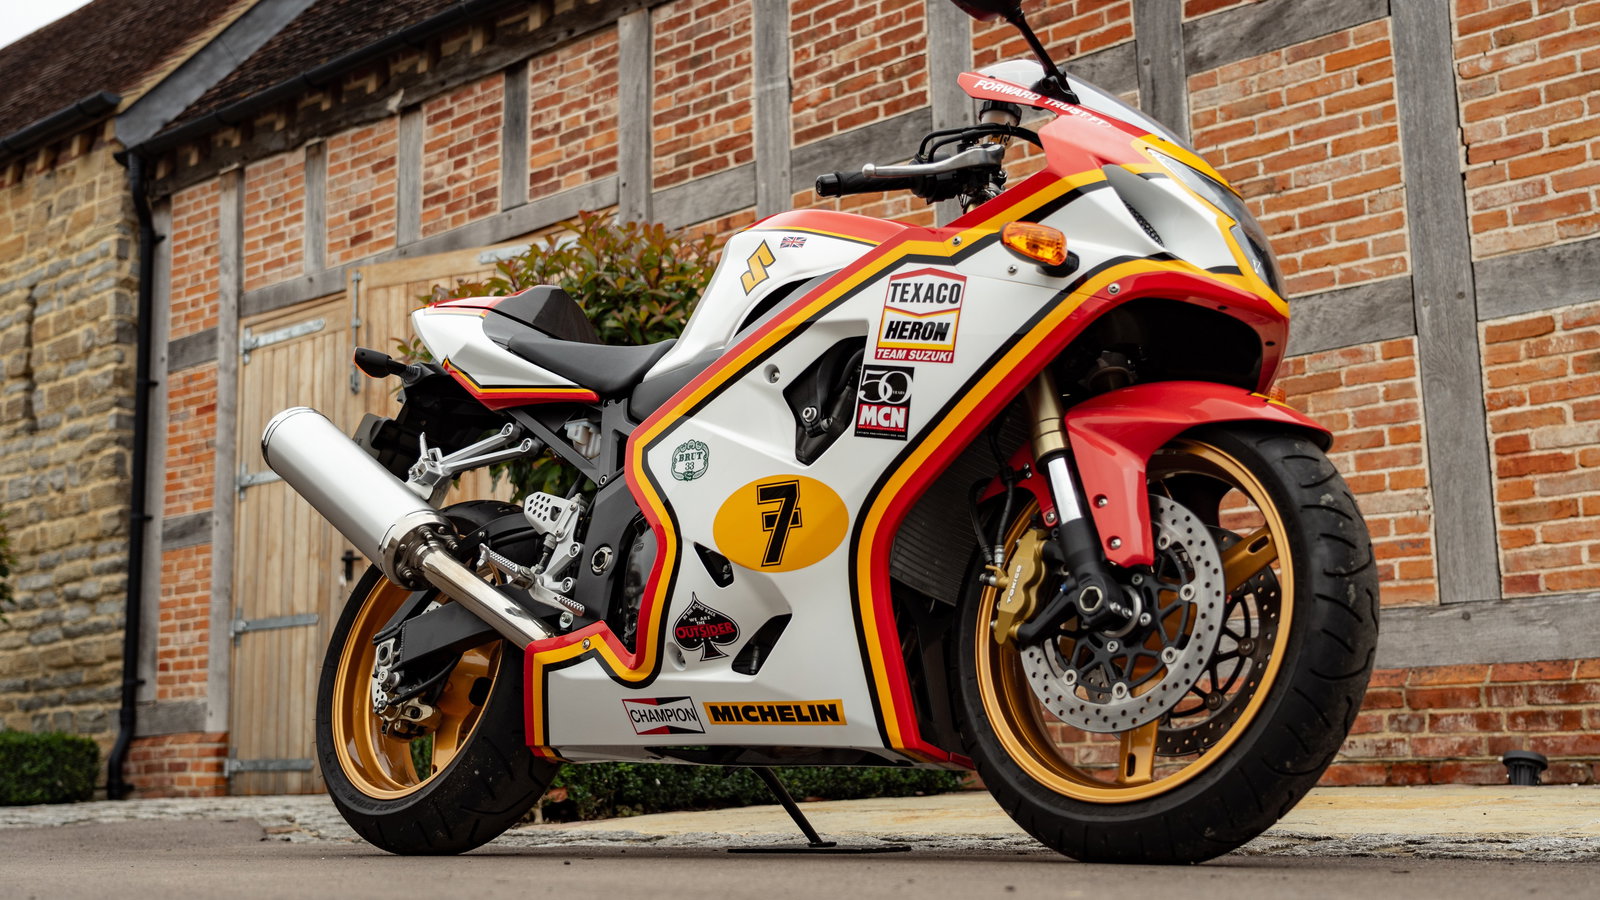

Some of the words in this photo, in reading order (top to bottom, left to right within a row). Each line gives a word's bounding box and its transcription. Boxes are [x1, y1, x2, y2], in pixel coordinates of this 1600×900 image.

[973, 79, 1041, 101] FORWARD
[1044, 97, 1089, 118] TRUST
[890, 282, 962, 304] TEXACO
[884, 320, 951, 341] HERON
[876, 348, 907, 359] TEAM
[908, 350, 953, 362] SUZUKI
[858, 369, 914, 405] 50
[858, 405, 907, 428] MCN
[678, 451, 703, 462] BRUT
[684, 461, 695, 471] 33
[757, 479, 803, 567] 7
[675, 621, 736, 639] OUTSIDER
[629, 707, 698, 723] CHAMPION
[709, 703, 840, 723] MICHELIN
